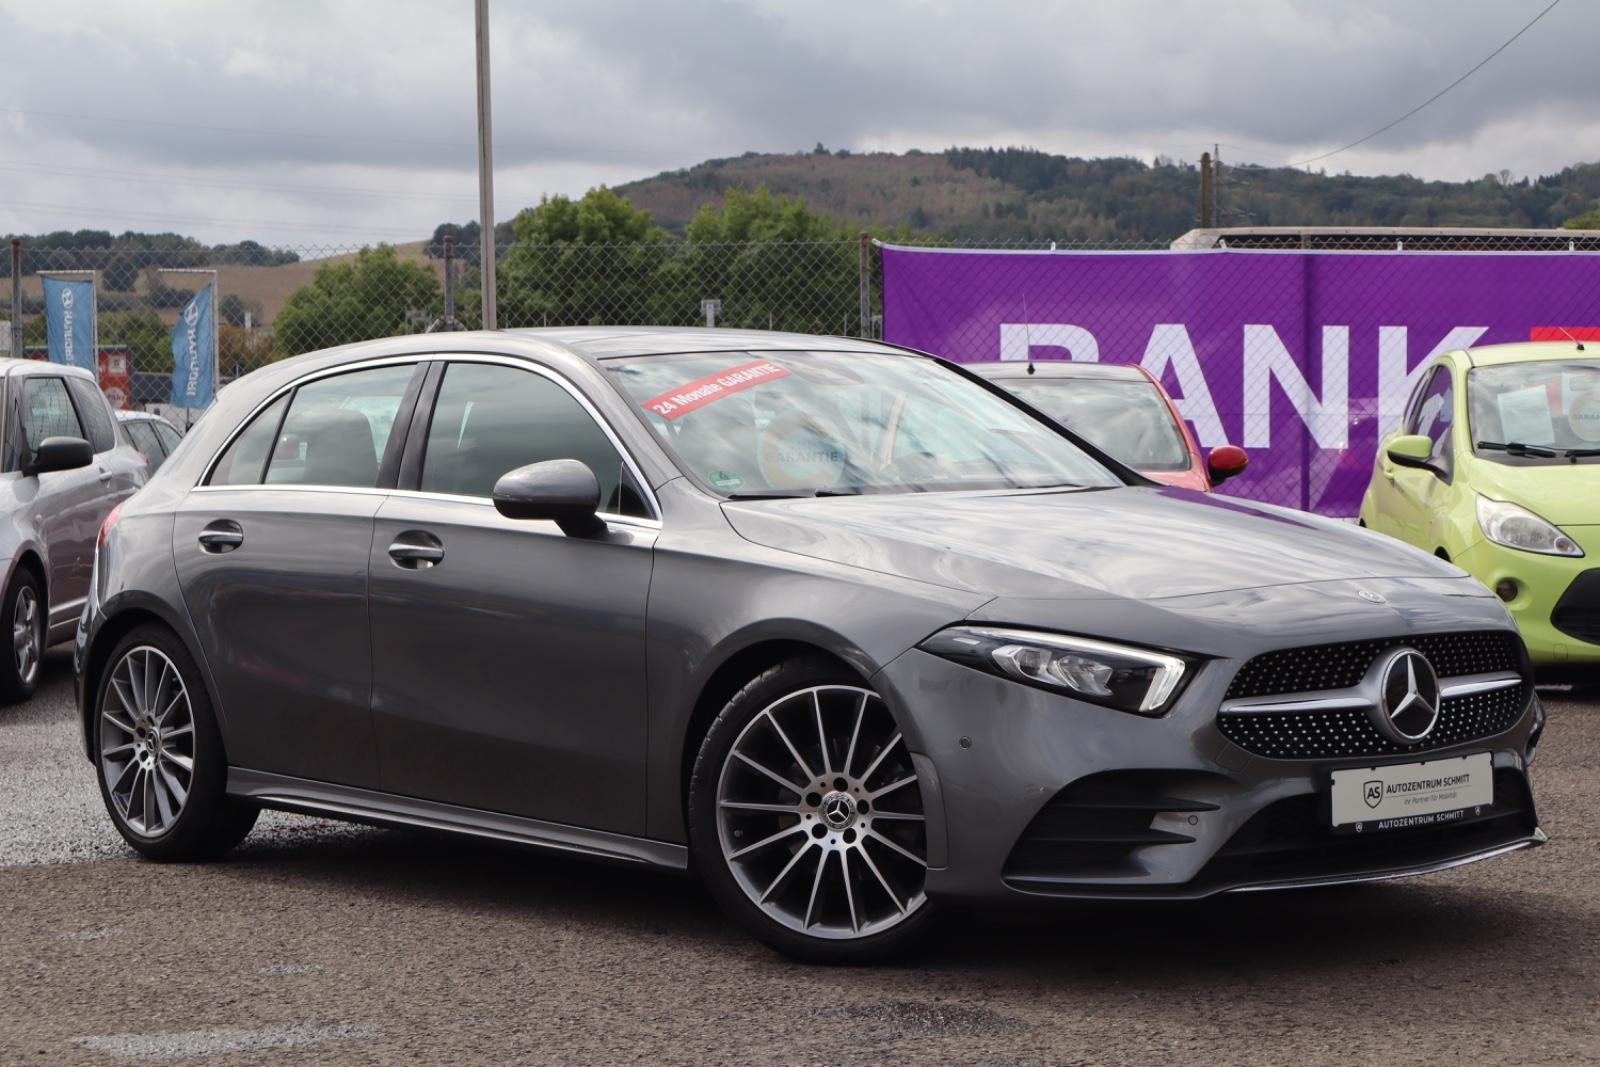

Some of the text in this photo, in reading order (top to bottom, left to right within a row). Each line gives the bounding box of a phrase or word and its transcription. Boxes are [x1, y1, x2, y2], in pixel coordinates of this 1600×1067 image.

[652, 363, 781, 415] 24 Monate GARANTIE
[1000, 323, 1490, 449] ANK
[1367, 786, 1381, 800] AS
[1386, 773, 1470, 794] AUTOZENTRUM SCHMITT
[1378, 810, 1464, 829] AUTOZENTRUM SCHMITT
